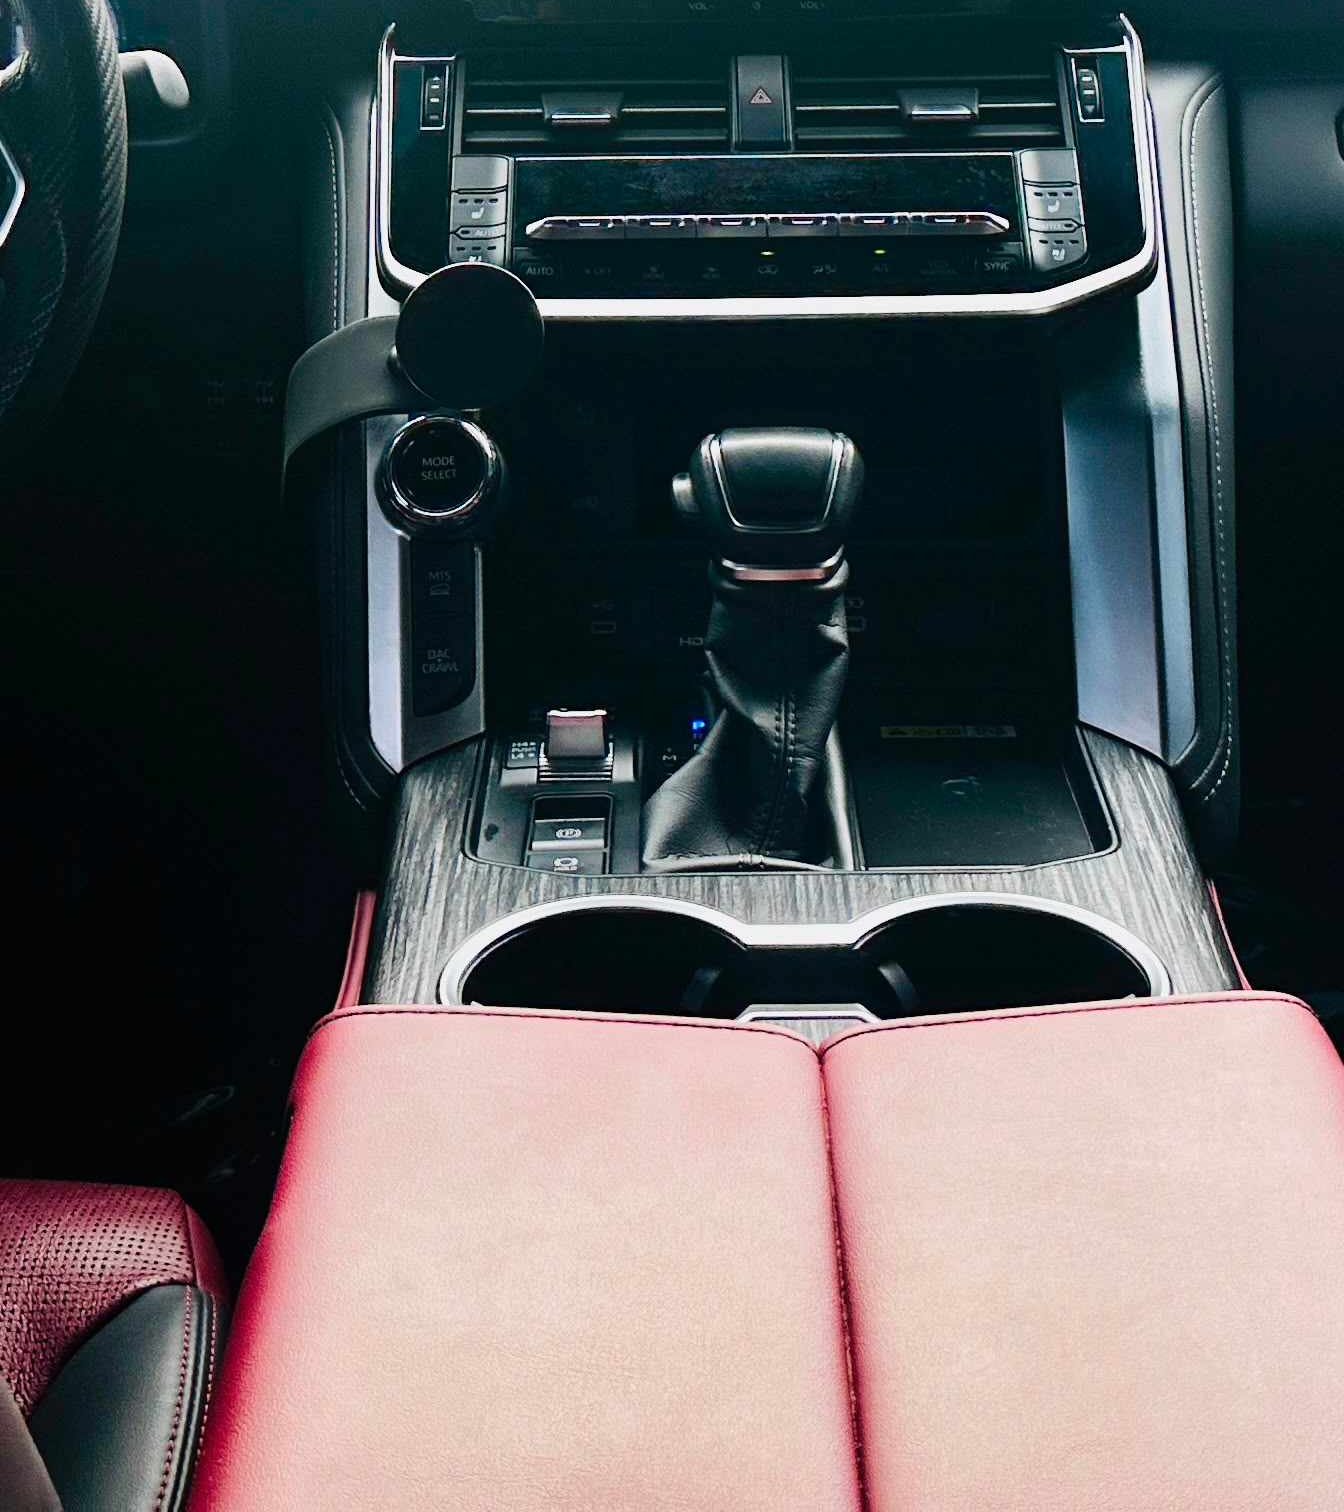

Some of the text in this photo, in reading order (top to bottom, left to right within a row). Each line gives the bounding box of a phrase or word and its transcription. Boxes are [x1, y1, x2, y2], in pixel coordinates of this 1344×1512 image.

[525, 265, 554, 276] AUTO
[983, 260, 1011, 272] SYNC
[421, 456, 456, 467] MODE
[421, 468, 457, 481] SELECT
[428, 571, 451, 582] MTS
[427, 649, 450, 660] DAC
[422, 661, 459, 674] CRAWL
[692, 721, 706, 730] P
